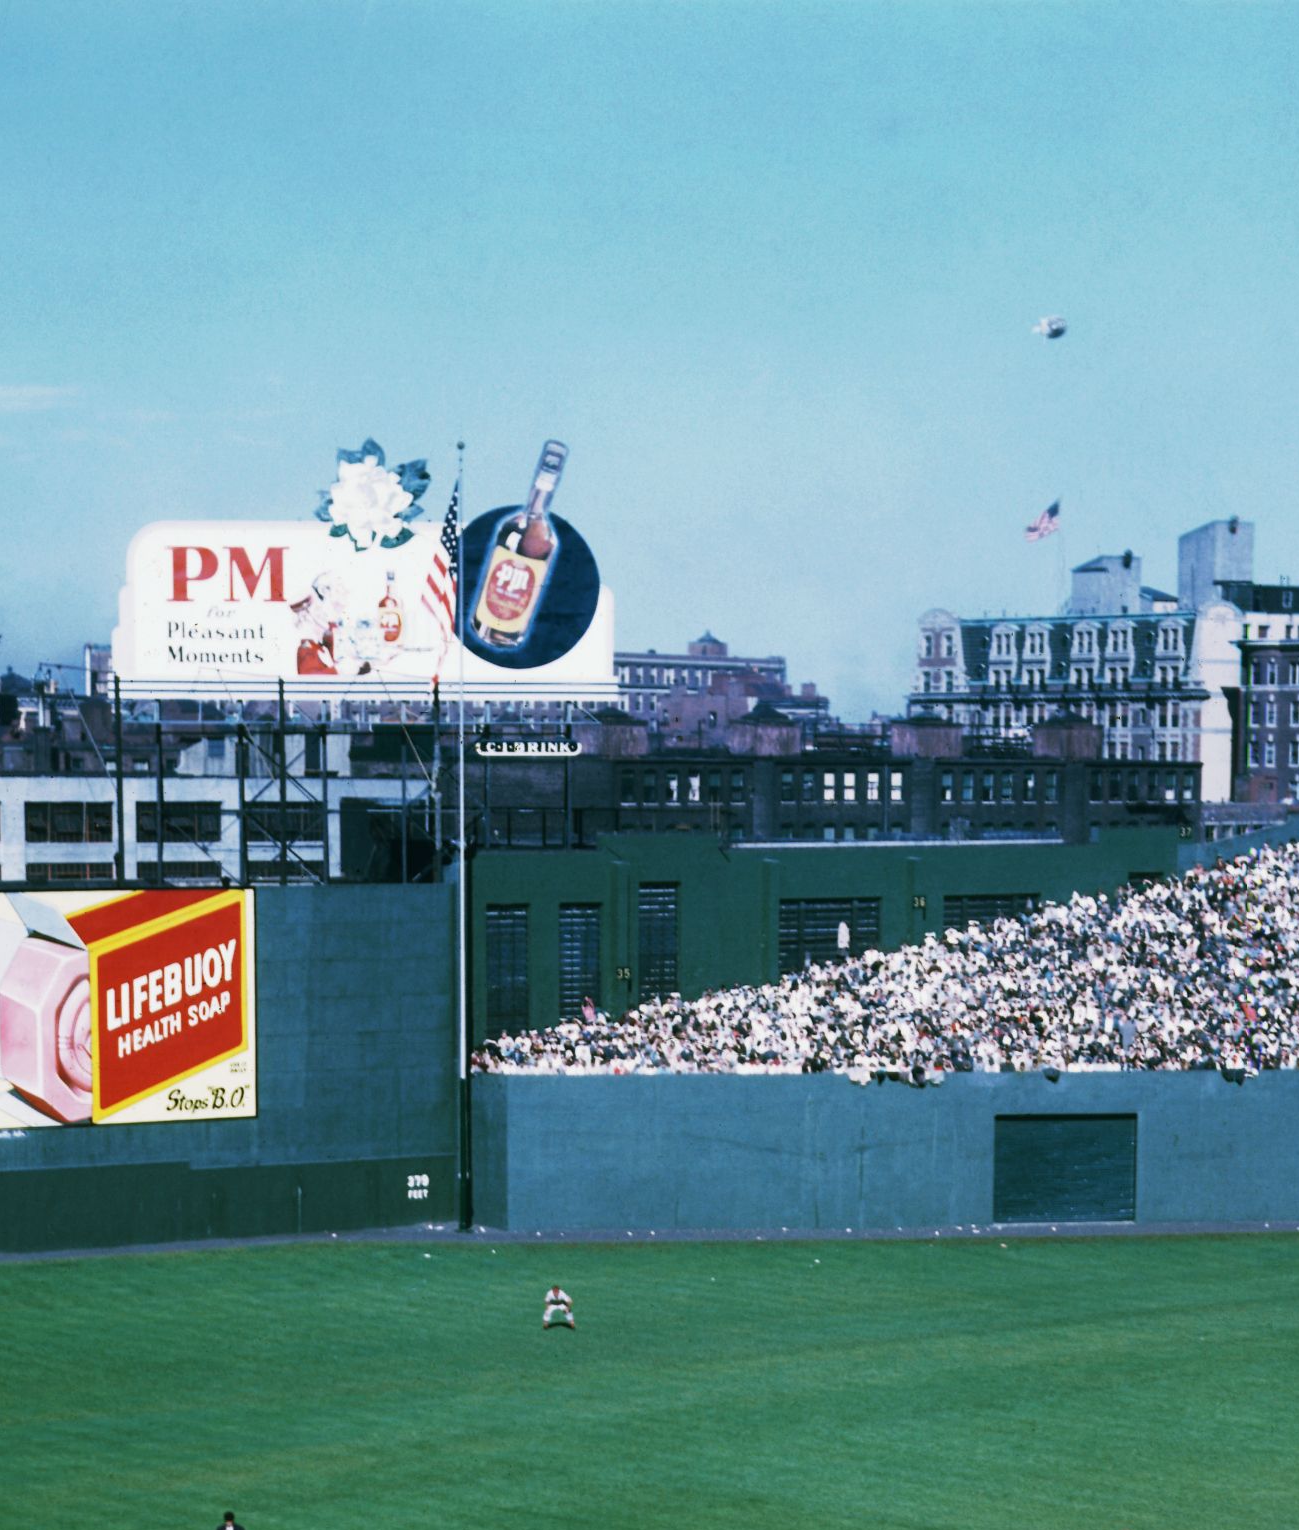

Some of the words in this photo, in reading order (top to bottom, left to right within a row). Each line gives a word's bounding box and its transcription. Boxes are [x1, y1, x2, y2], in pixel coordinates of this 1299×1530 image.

[165, 546, 290, 602] PM
[206, 606, 237, 618] for
[168, 621, 265, 640] Pleasant
[168, 646, 264, 663] Moments
[106, 938, 236, 1031] LIFEBUOY
[117, 1011, 182, 1059] HEALTH
[188, 991, 231, 1027] SOAP
[166, 1088, 209, 1113] Stops
